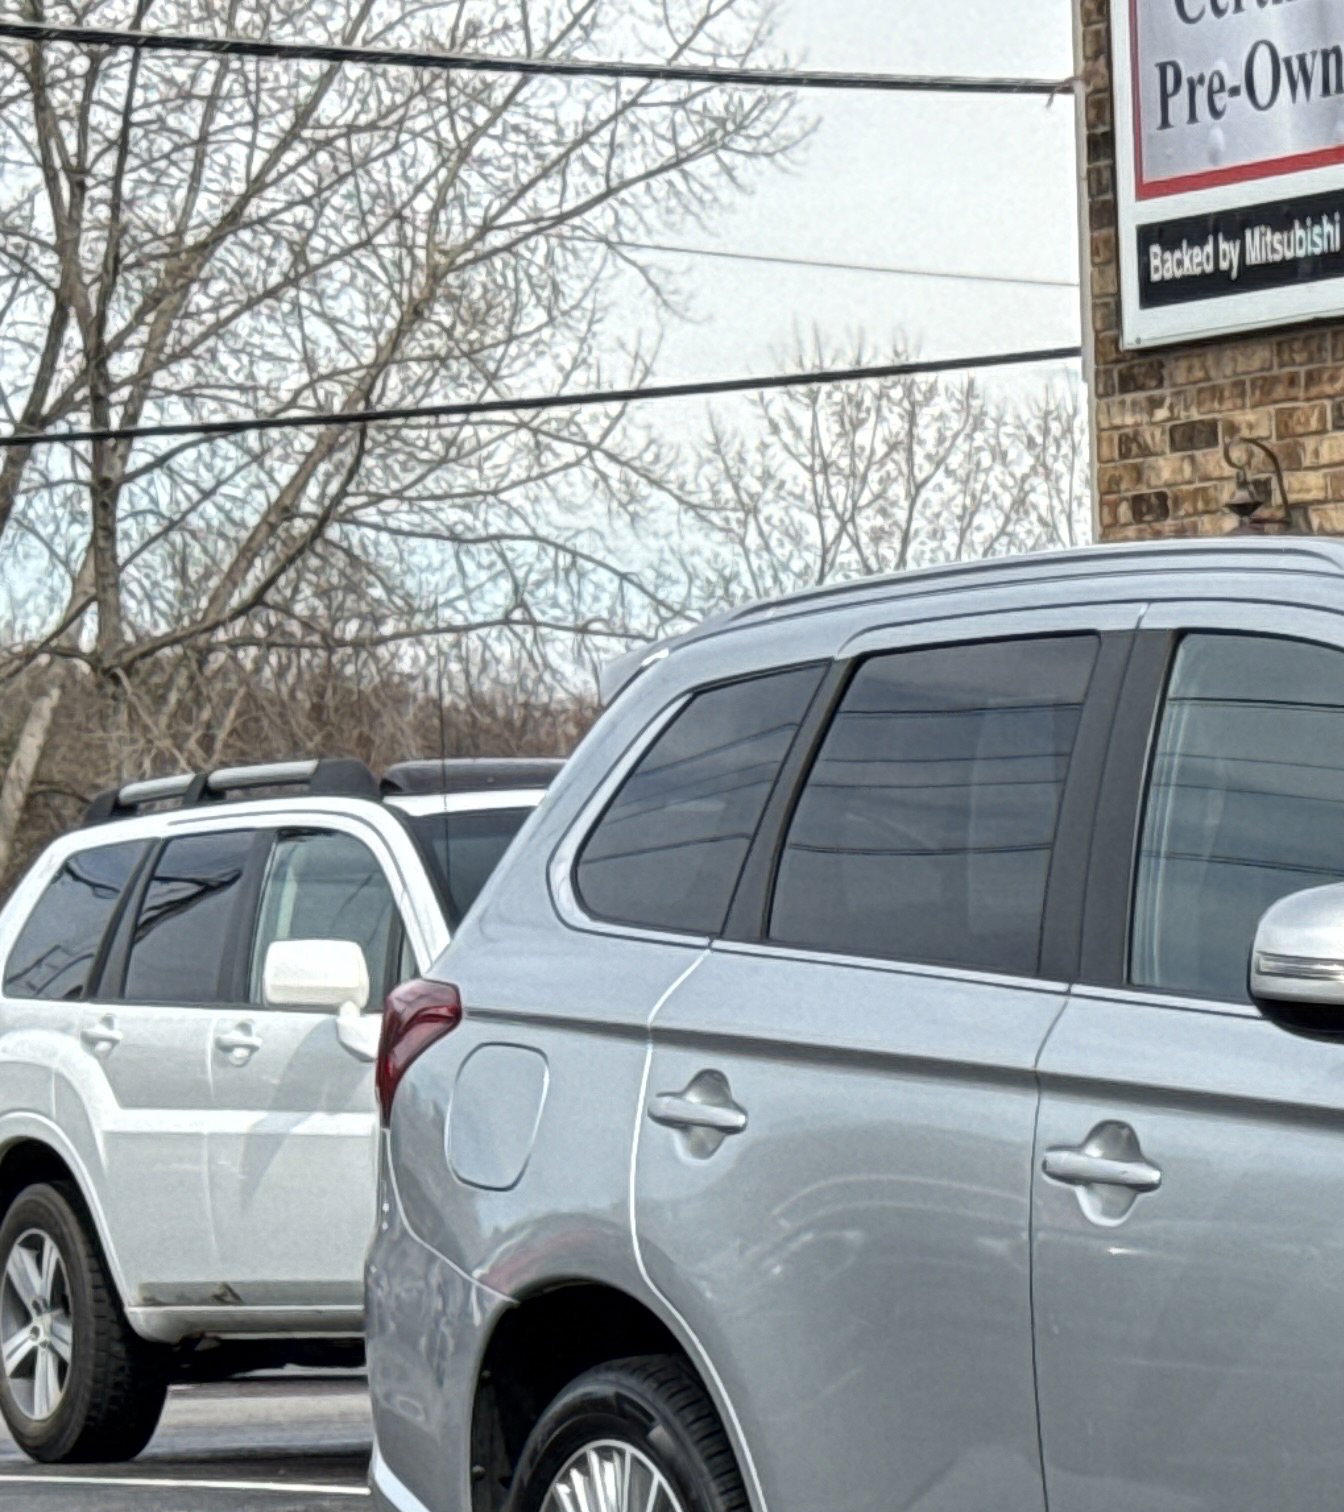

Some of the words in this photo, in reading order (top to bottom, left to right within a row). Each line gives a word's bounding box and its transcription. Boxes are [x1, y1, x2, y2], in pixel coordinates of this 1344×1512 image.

[1149, 234, 1214, 283] Backed
[1219, 232, 1241, 281] by
[1244, 211, 1341, 266] Mitsubishi
